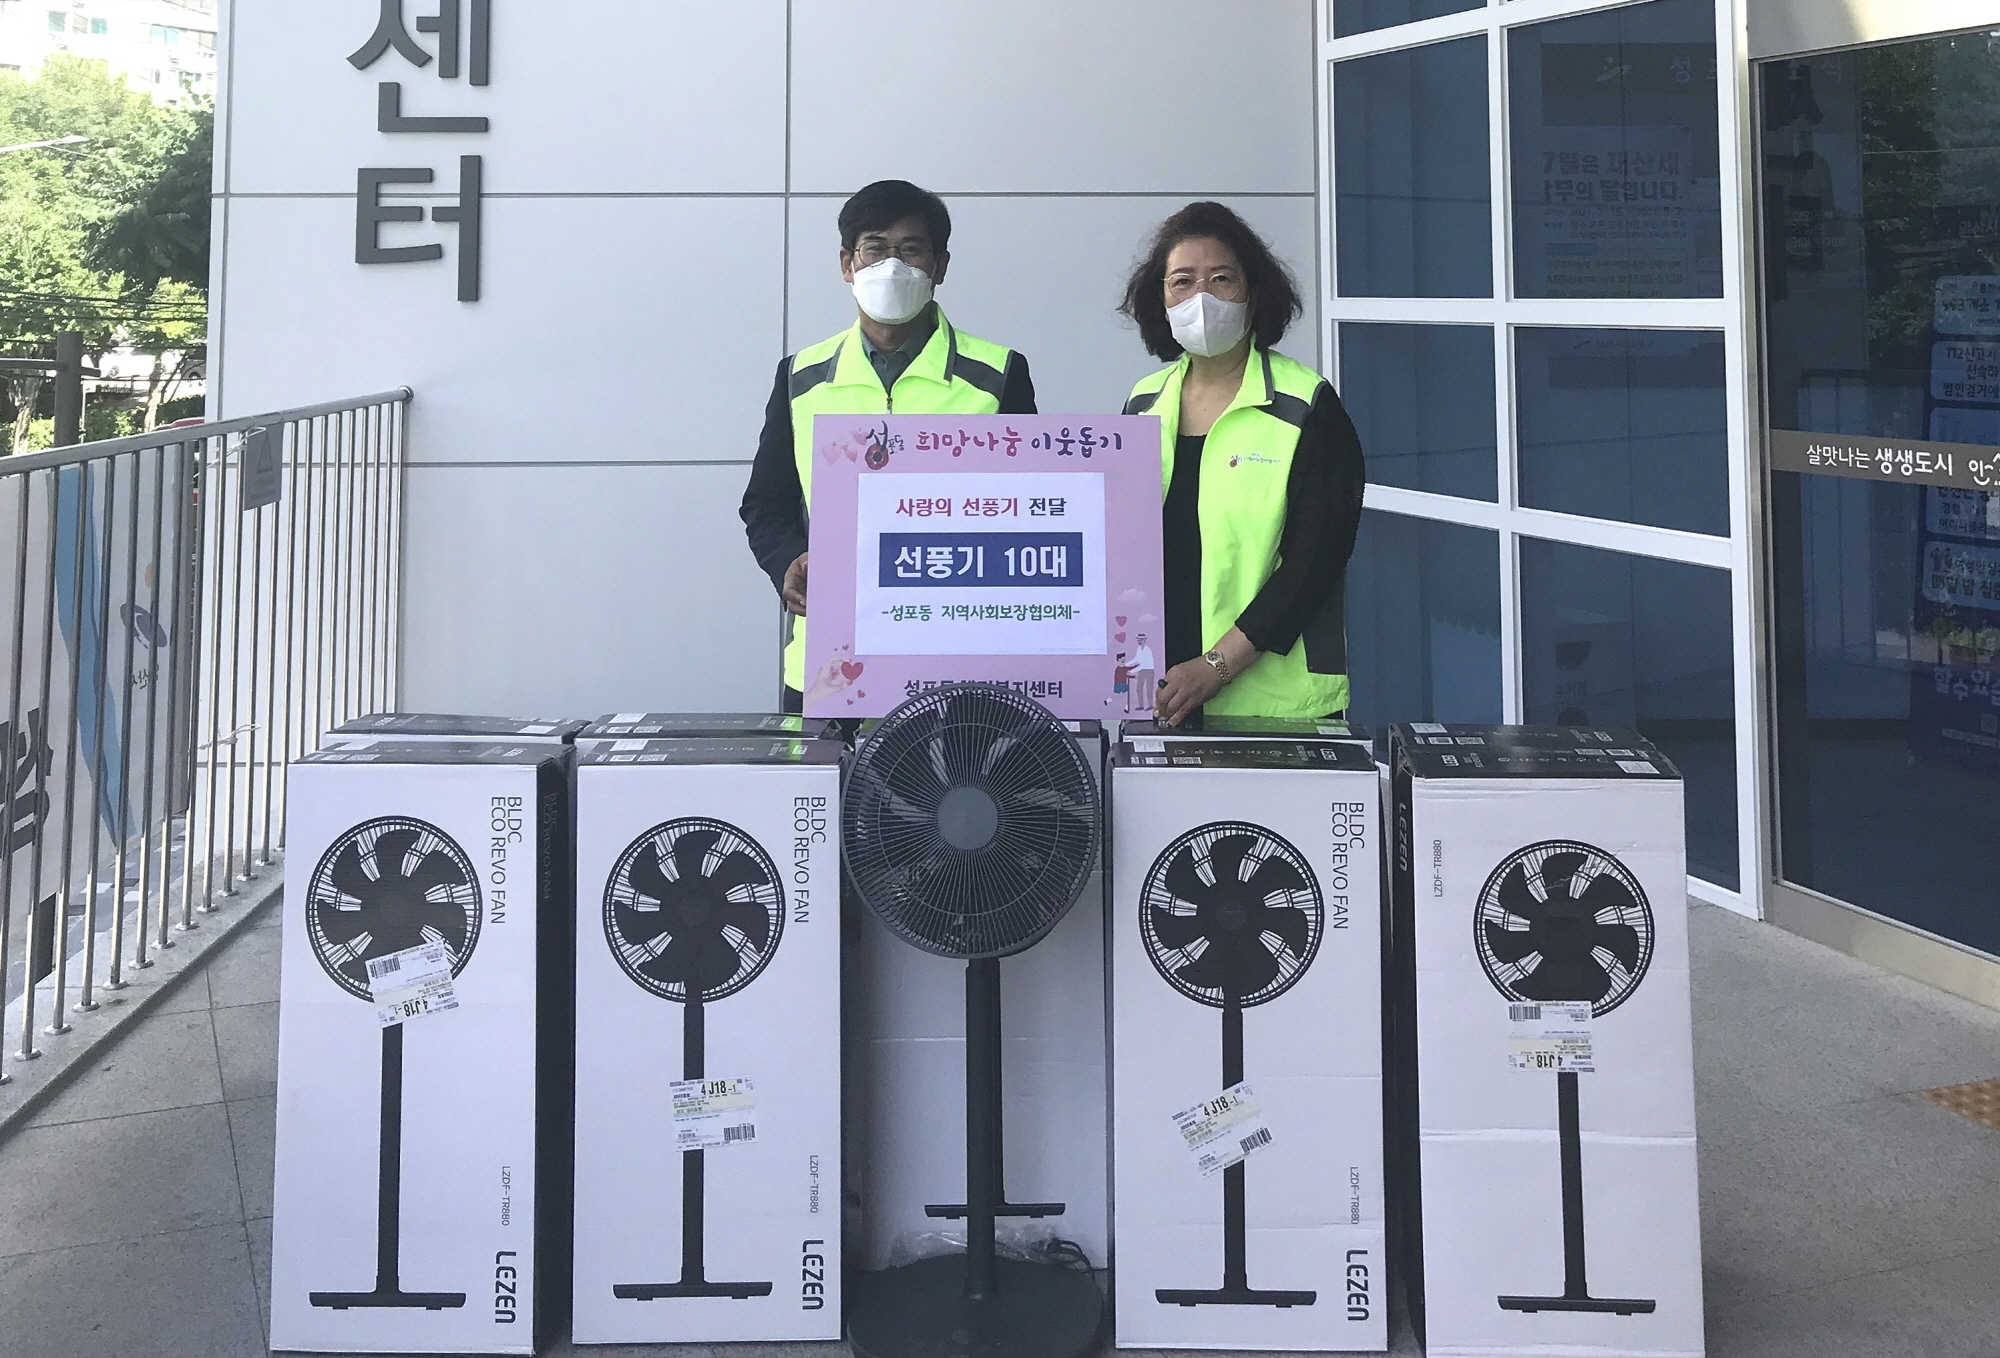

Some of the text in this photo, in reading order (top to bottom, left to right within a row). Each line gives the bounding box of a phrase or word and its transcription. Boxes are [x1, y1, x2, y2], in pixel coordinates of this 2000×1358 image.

[1031, 426, 1123, 459] 이웃돕기
[1806, 444, 1871, 469] 살맛나는
[1874, 447, 1953, 476] 생생도시
[896, 497, 1067, 517] 사랑의 선풍기 전달
[894, 545, 1067, 579] 선풍기 10대
[507, 796, 522, 843] BLDC
[810, 797, 826, 843] BLDC
[1349, 802, 1365, 849] BLDC
[1399, 803, 1409, 872] LEZEN
[491, 796, 506, 924] ECO REVO FAN
[794, 797, 809, 923] ECO REVO FAN
[1331, 802, 1349, 929] ECO REVO FAN
[1433, 839, 1443, 898] LZDF-TR880
[501, 1165, 510, 1226] LZDF-TR880
[809, 1154, 819, 1214] LZDF-TR880
[1349, 1165, 1360, 1225] LZDF-TR880
[495, 1250, 517, 1325] LEZEN
[802, 1239, 824, 1311] LEZEN
[1345, 1249, 1370, 1322] LEZEN
